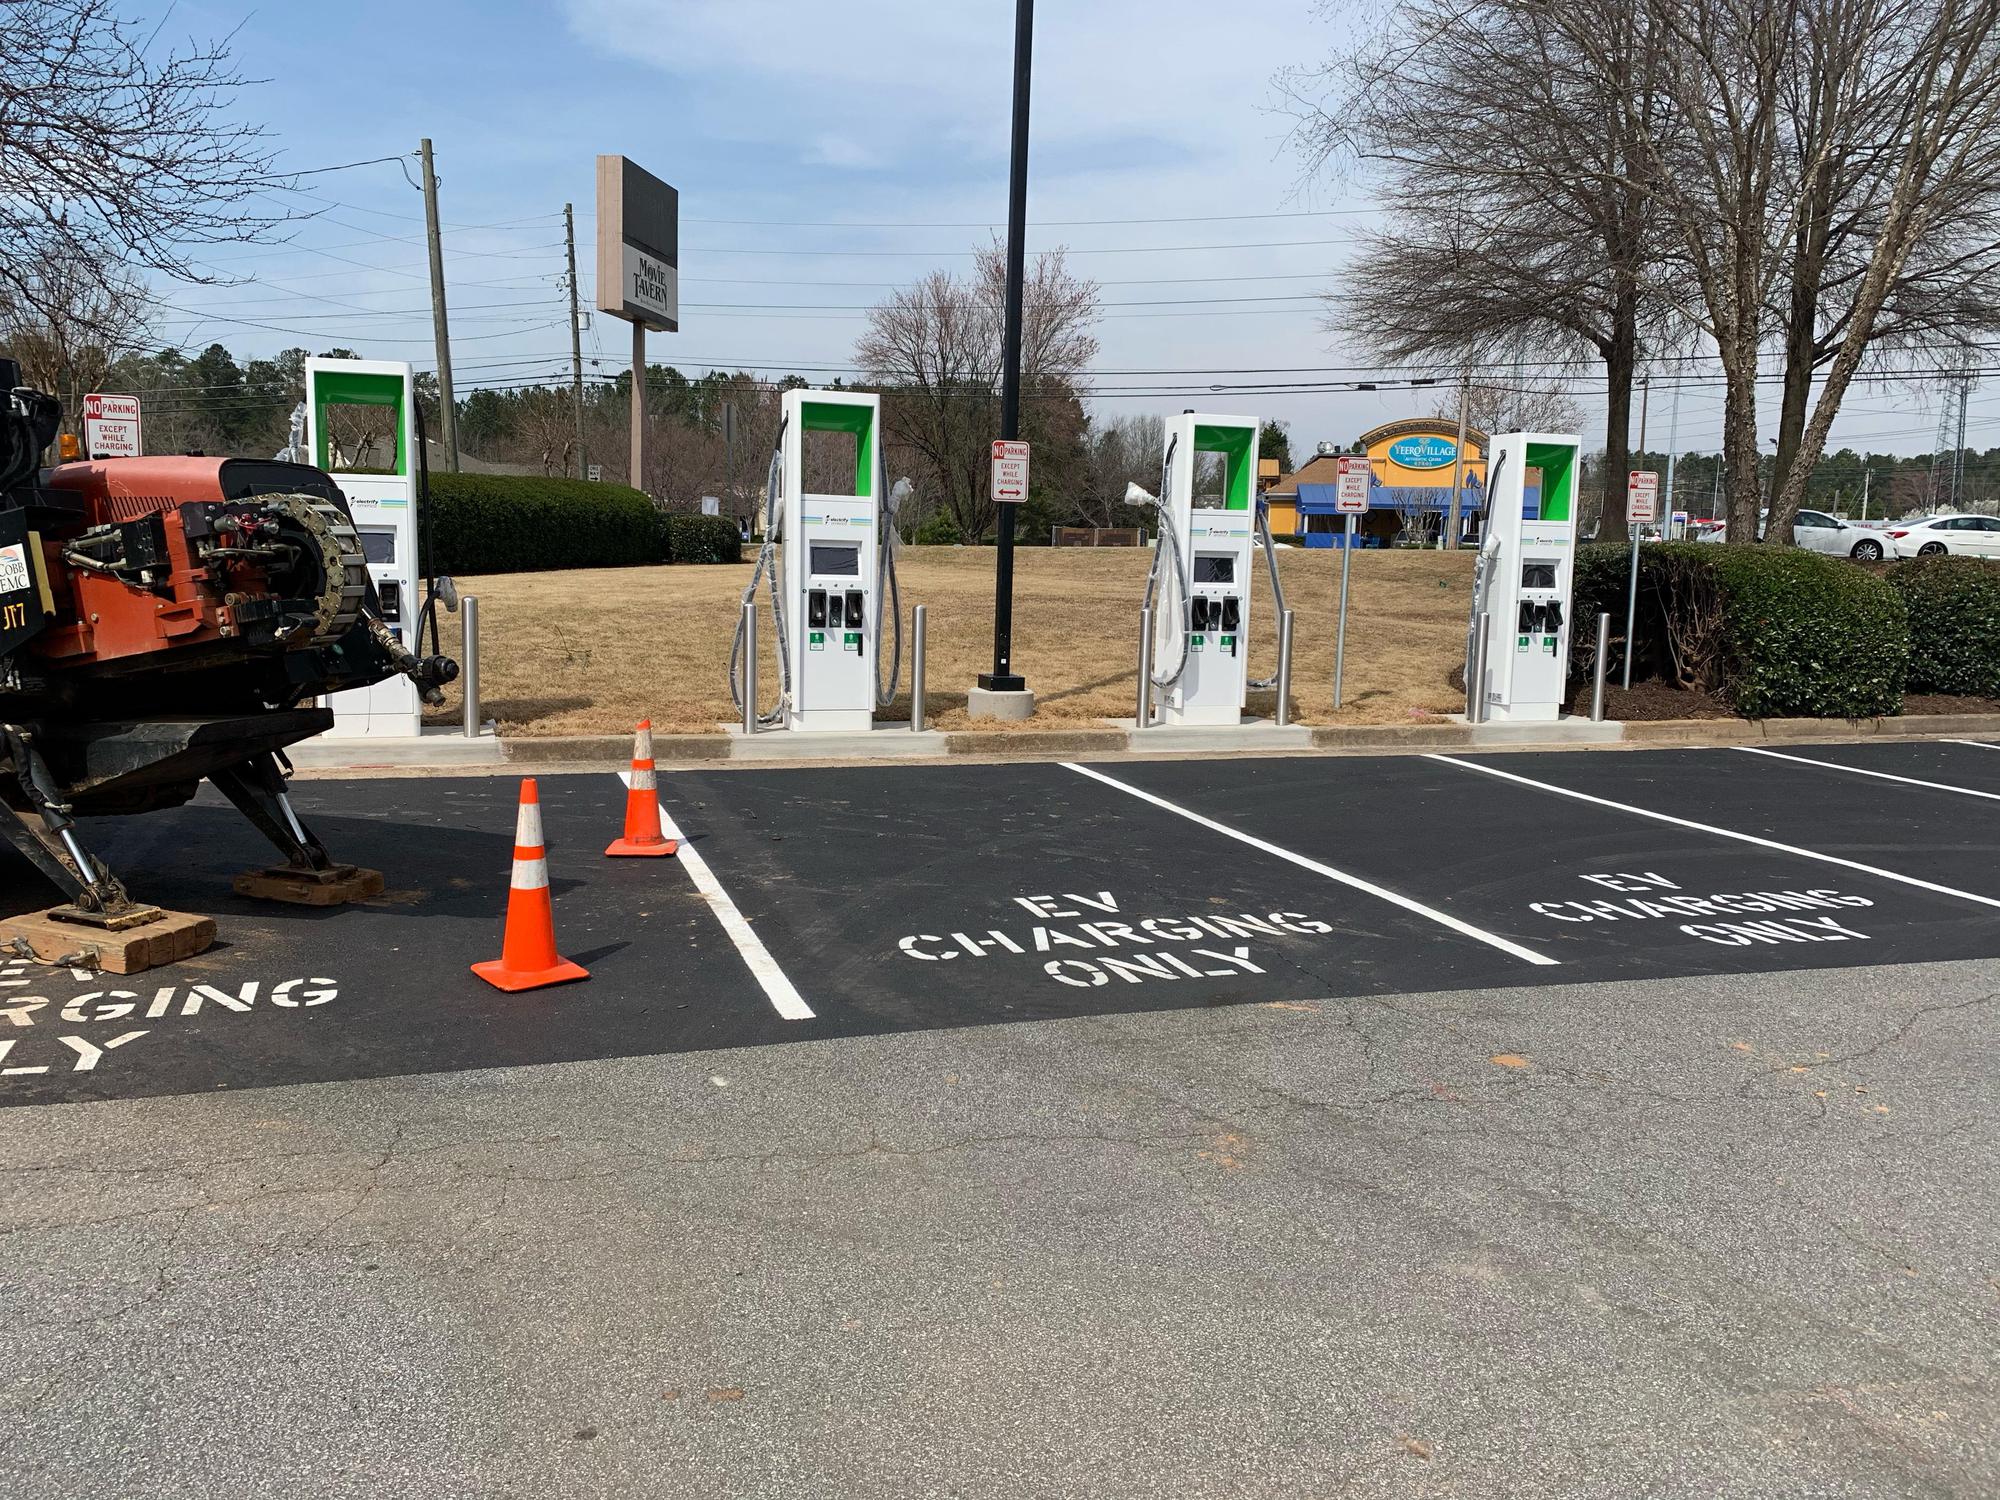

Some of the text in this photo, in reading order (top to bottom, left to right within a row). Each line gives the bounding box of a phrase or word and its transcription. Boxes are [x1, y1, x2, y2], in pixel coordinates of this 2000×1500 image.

[639, 257, 666, 286] MOVIE
[633, 272, 667, 311] TAVERN
[86, 400, 136, 415] NO PARKING
[99, 425, 127, 433] EXCEPT
[101, 433, 125, 442] WHILE
[94, 442, 133, 451] CHARGING
[994, 445, 1027, 457] NO PARKING
[1339, 460, 1369, 472] NO PARKING
[1630, 475, 1638, 486] NO
[0, 561, 25, 578] COBB
[0, 573, 27, 592] EMC
[1579, 872, 1682, 891] EV
[1013, 891, 1121, 919] EV
[1529, 889, 1874, 922] CHARGING
[899, 912, 1334, 961] CHARGING
[1679, 916, 1872, 946] ONLY
[1043, 946, 1268, 988] ONLY
